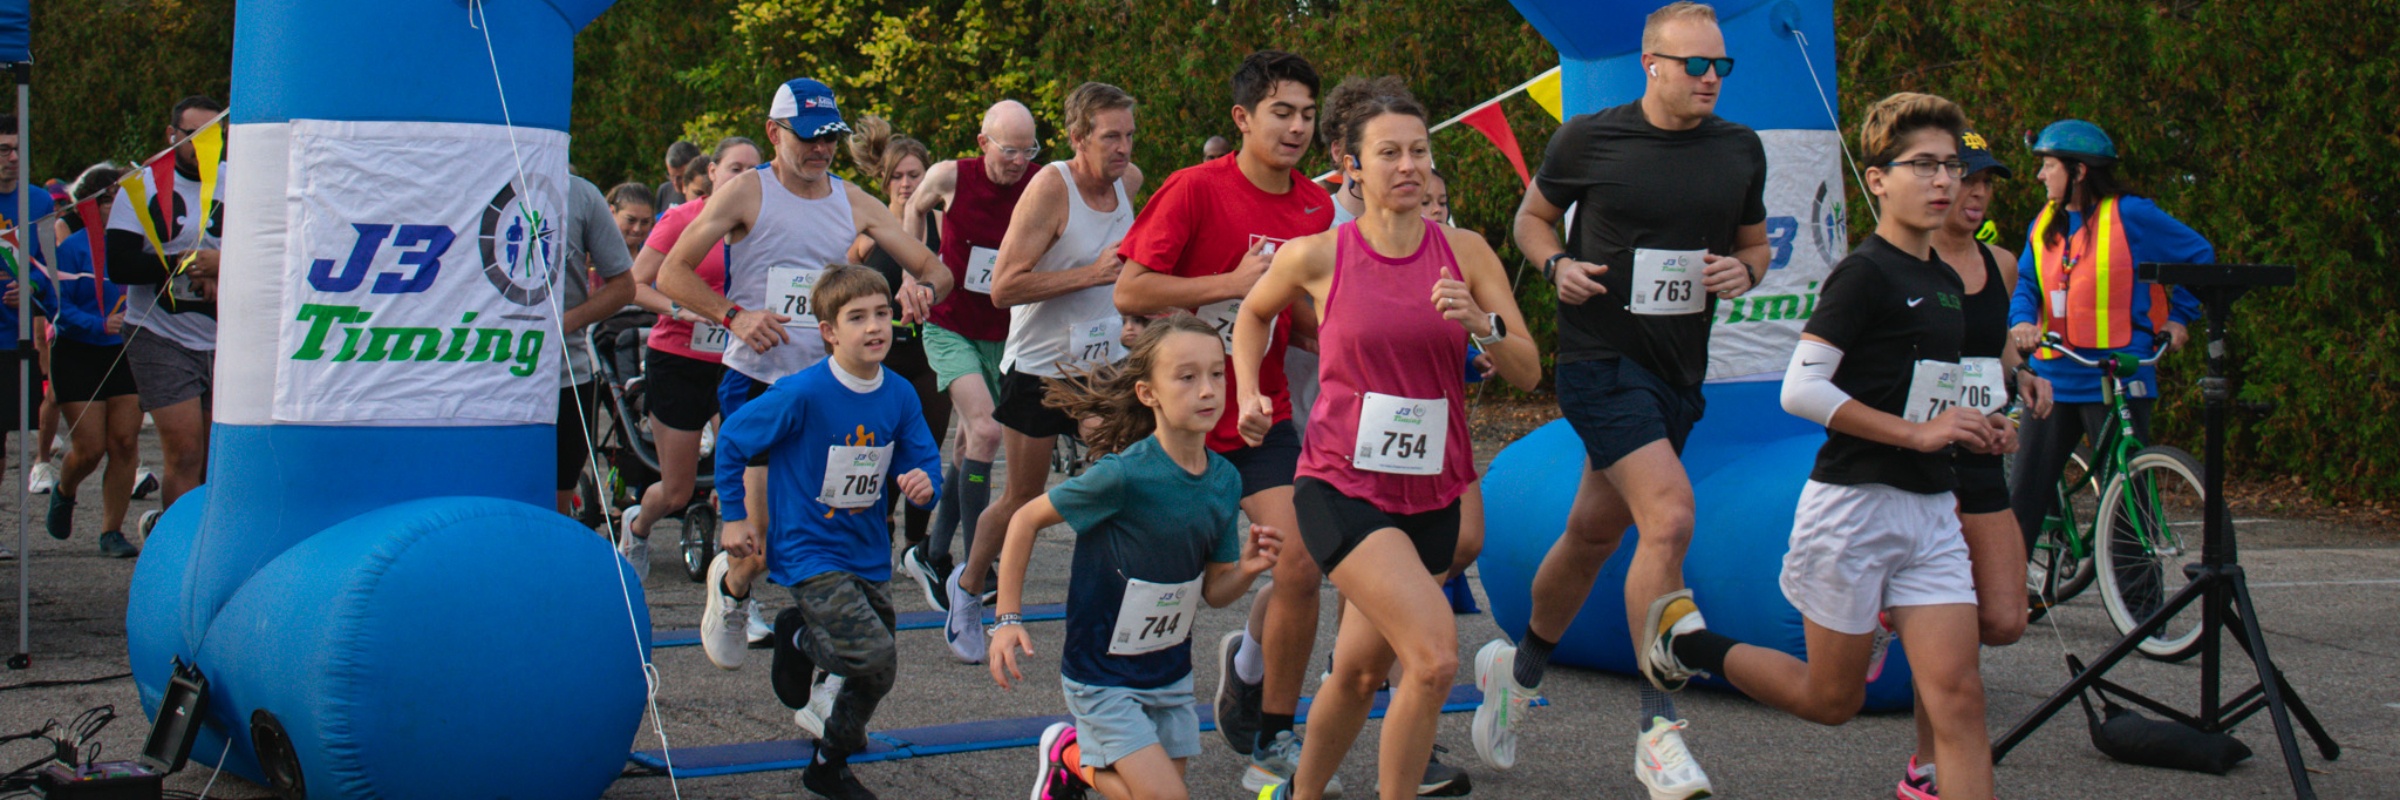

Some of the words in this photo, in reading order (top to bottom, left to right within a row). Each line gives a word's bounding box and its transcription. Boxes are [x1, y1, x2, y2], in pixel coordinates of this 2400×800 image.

[1766, 215, 1799, 270] 3
[307, 223, 457, 294] J3
[1653, 279, 1692, 302] 763
[1712, 280, 1820, 324] imi
[783, 294, 815, 316] 78
[291, 303, 546, 377] Timing
[706, 327, 726, 343] 77
[1083, 340, 1109, 360] 773
[1395, 407, 1411, 416] J3
[1381, 430, 1427, 459] 754
[842, 473, 879, 496] 705
[1139, 611, 1181, 640] 744
